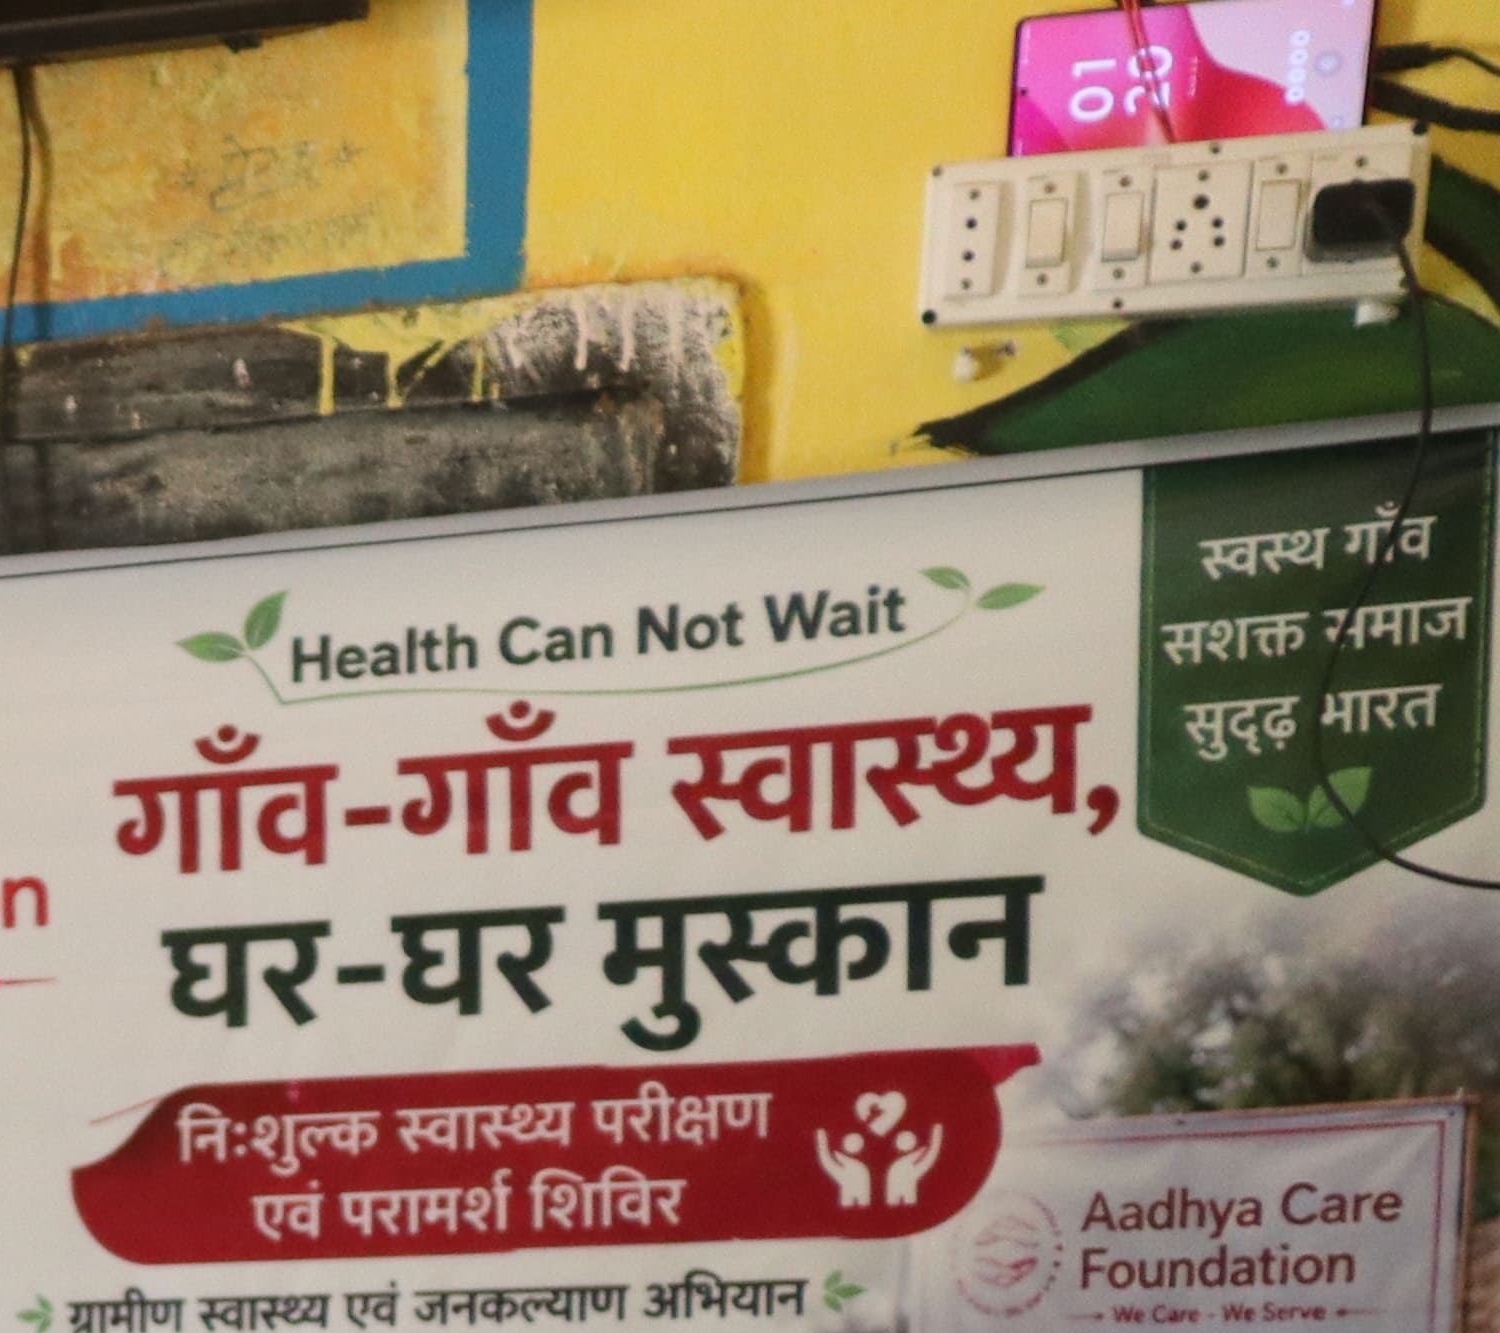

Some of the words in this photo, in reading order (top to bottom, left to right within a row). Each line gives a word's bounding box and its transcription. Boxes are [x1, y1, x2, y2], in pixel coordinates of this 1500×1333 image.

[1198, 527, 1331, 581] स्वस्थ
[1344, 501, 1438, 564] गाँव
[290, 624, 478, 683] Health
[498, 615, 613, 667] Can
[636, 602, 744, 655] Not
[761, 585, 907, 642] Wait
[1161, 612, 1309, 665] सशक्त
[1323, 597, 1473, 649] समाज
[1321, 683, 1443, 733] भारत
[112, 699, 634, 875] गाँव-गाँव
[666, 703, 1121, 841] स्वास्थ्य,
[161, 905, 566, 1030] घर-घर
[598, 873, 1045, 1051] मुस्कान
[395, 1100, 575, 1159] स्वास्थ्य
[592, 1083, 773, 1148] परीक्षण
[251, 1182, 324, 1245] एवं
[341, 1169, 513, 1238] परामर्श
[527, 1167, 687, 1229] शिविर
[1081, 1188, 1264, 1239] Aadhya
[1280, 1182, 1404, 1226] Care
[197, 1289, 330, 1333] स्वास्थ्य
[343, 1276, 400, 1328] एवं
[414, 1282, 629, 1328] जनकल्याण
[642, 1268, 809, 1320] अभियान
[1080, 1244, 1356, 1292] Foundation
[1112, 1304, 1148, 1323] We
[1152, 1305, 1200, 1324] Care
[1221, 1303, 1258, 1322] We
[1263, 1303, 1326, 1322] Serve
